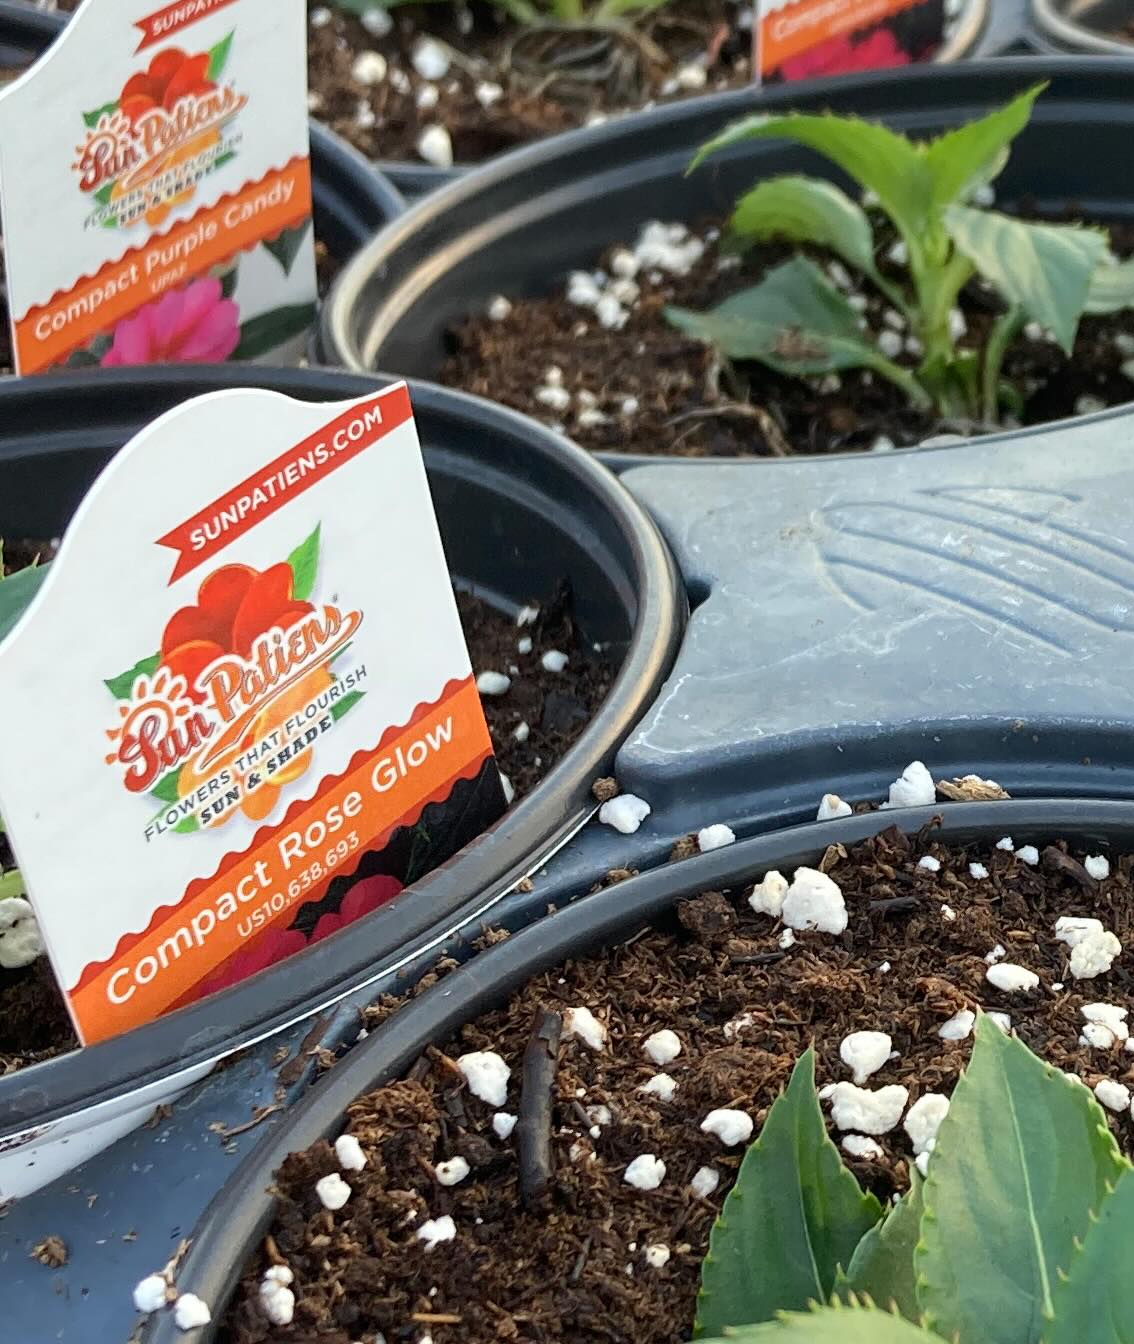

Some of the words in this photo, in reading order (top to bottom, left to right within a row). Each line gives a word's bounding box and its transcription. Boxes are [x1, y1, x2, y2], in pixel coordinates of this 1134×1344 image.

[34, 264, 138, 341] Compact
[145, 221, 218, 274] Purple
[223, 177, 296, 229] Candy
[189, 405, 384, 551] SUNPATIENS.COM
[118, 711, 216, 792] Sun
[201, 605, 345, 722] Patiens
[143, 770, 232, 843] FLOWERS
[234, 732, 281, 772] THAT
[284, 664, 368, 737] FLOURISH
[201, 785, 241, 825] SUN
[247, 771, 263, 790] &
[266, 715, 333, 775] SHADE
[106, 860, 272, 1004] Compact
[278, 790, 363, 870] Rose
[370, 716, 453, 794] Glow
[236, 830, 361, 938] US10,638,693
